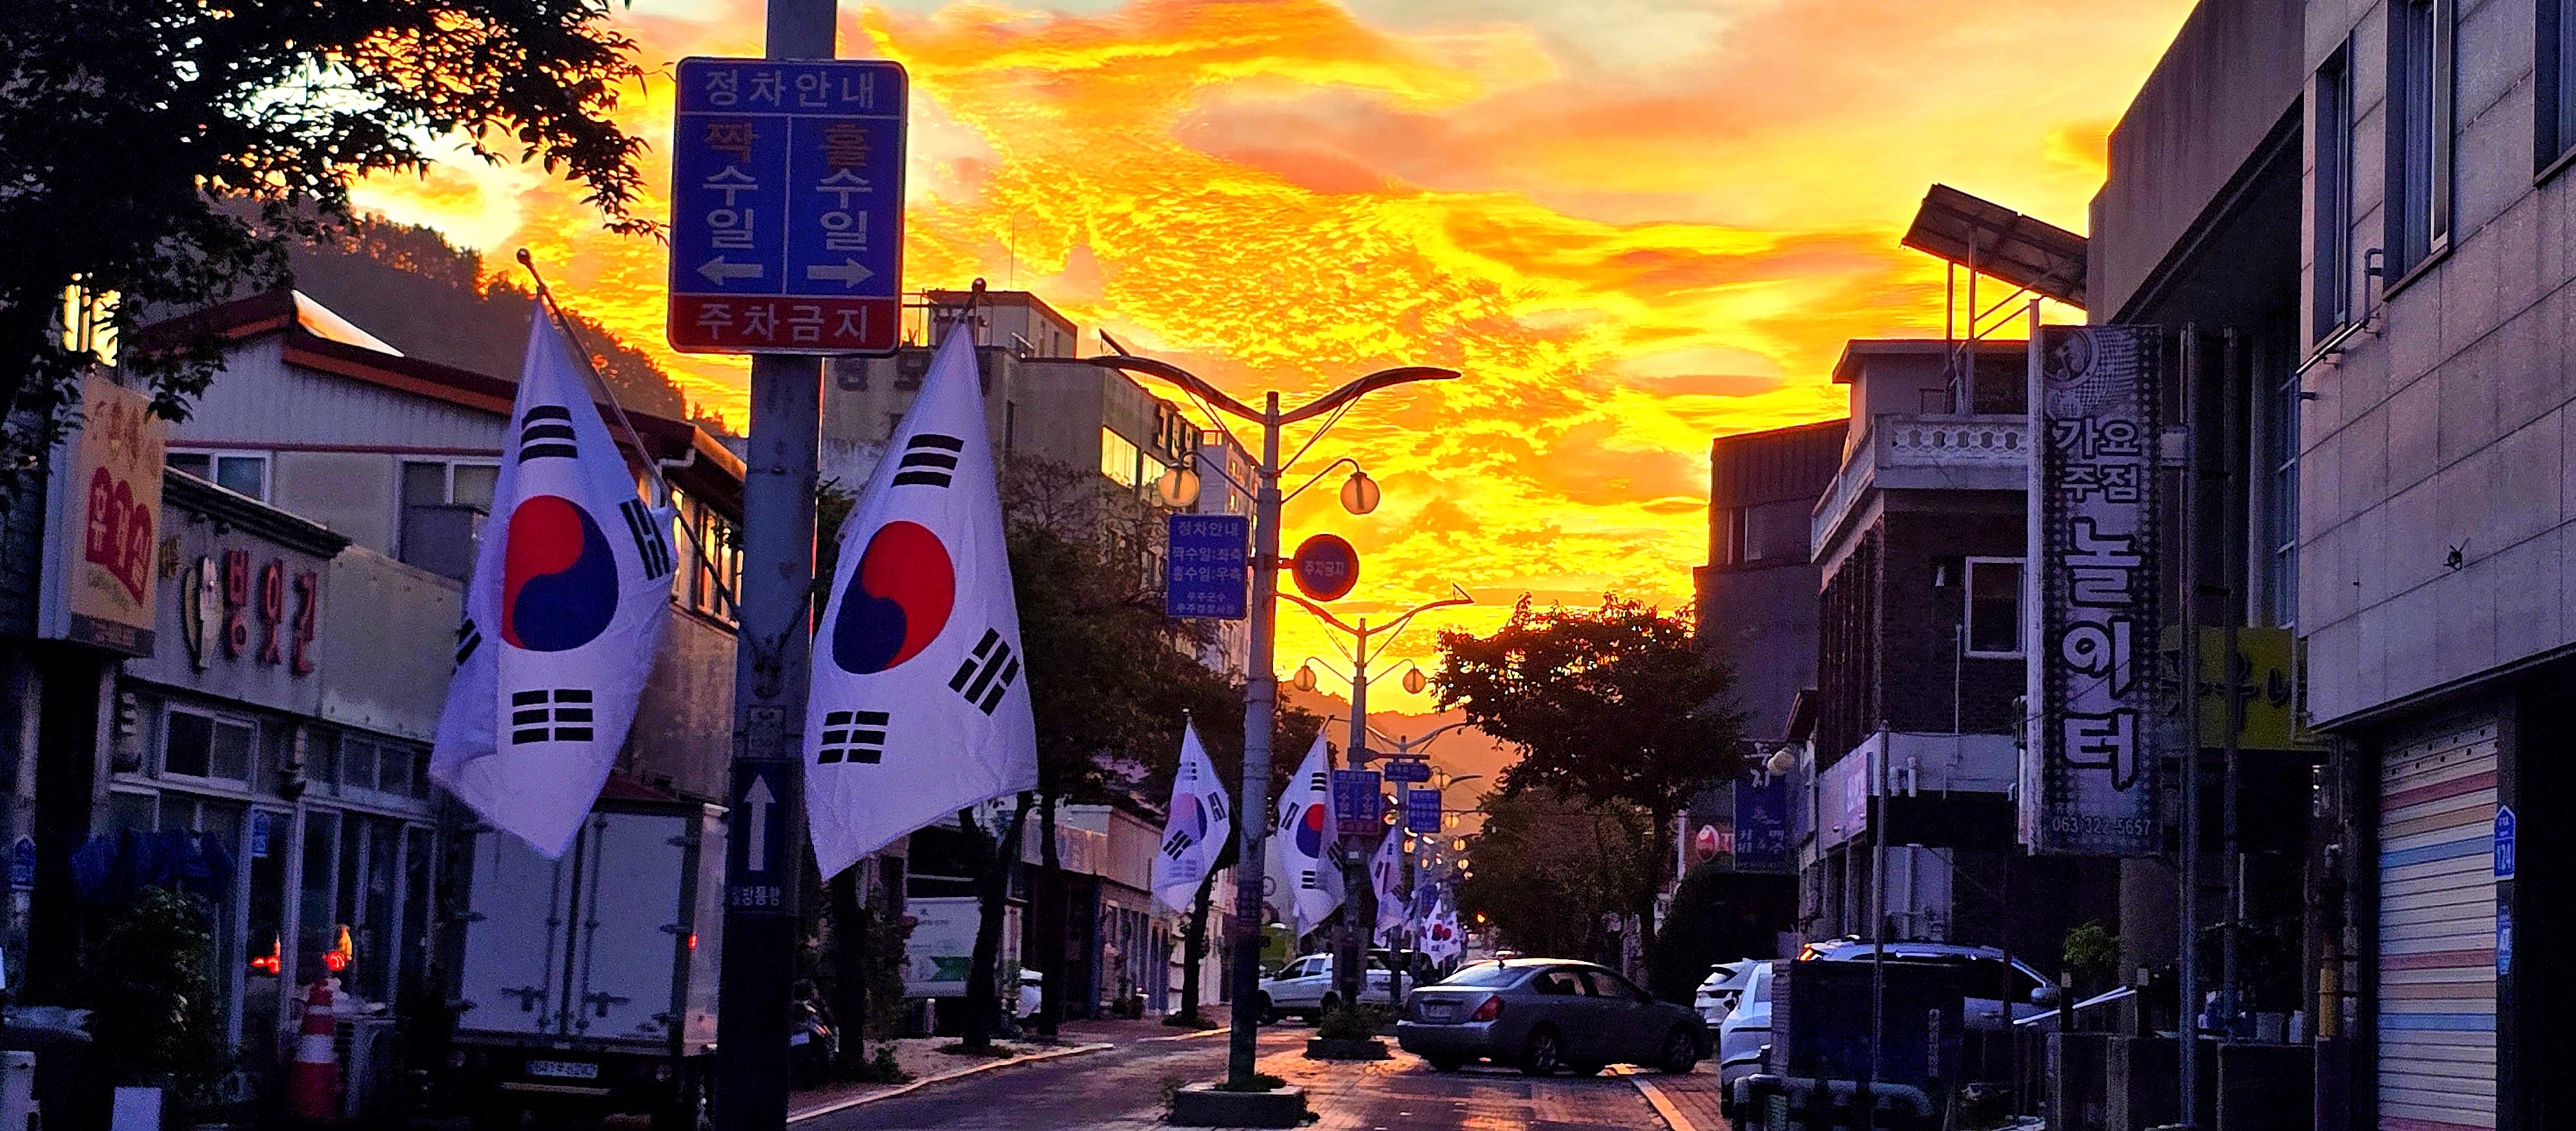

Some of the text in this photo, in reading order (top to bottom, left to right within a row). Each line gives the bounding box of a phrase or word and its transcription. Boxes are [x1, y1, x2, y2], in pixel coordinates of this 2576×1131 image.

[706, 68, 875, 108] 정차안내
[702, 121, 759, 249] 짝수일
[815, 123, 872, 251] 홀수일
[697, 303, 868, 343] 주차금지
[2056, 417, 2140, 457] 가요
[2061, 465, 2139, 502] 주점
[1178, 521, 1239, 536] 정차안내
[1305, 560, 1344, 577] 주차금지
[2062, 522, 2142, 784] 놀이터
